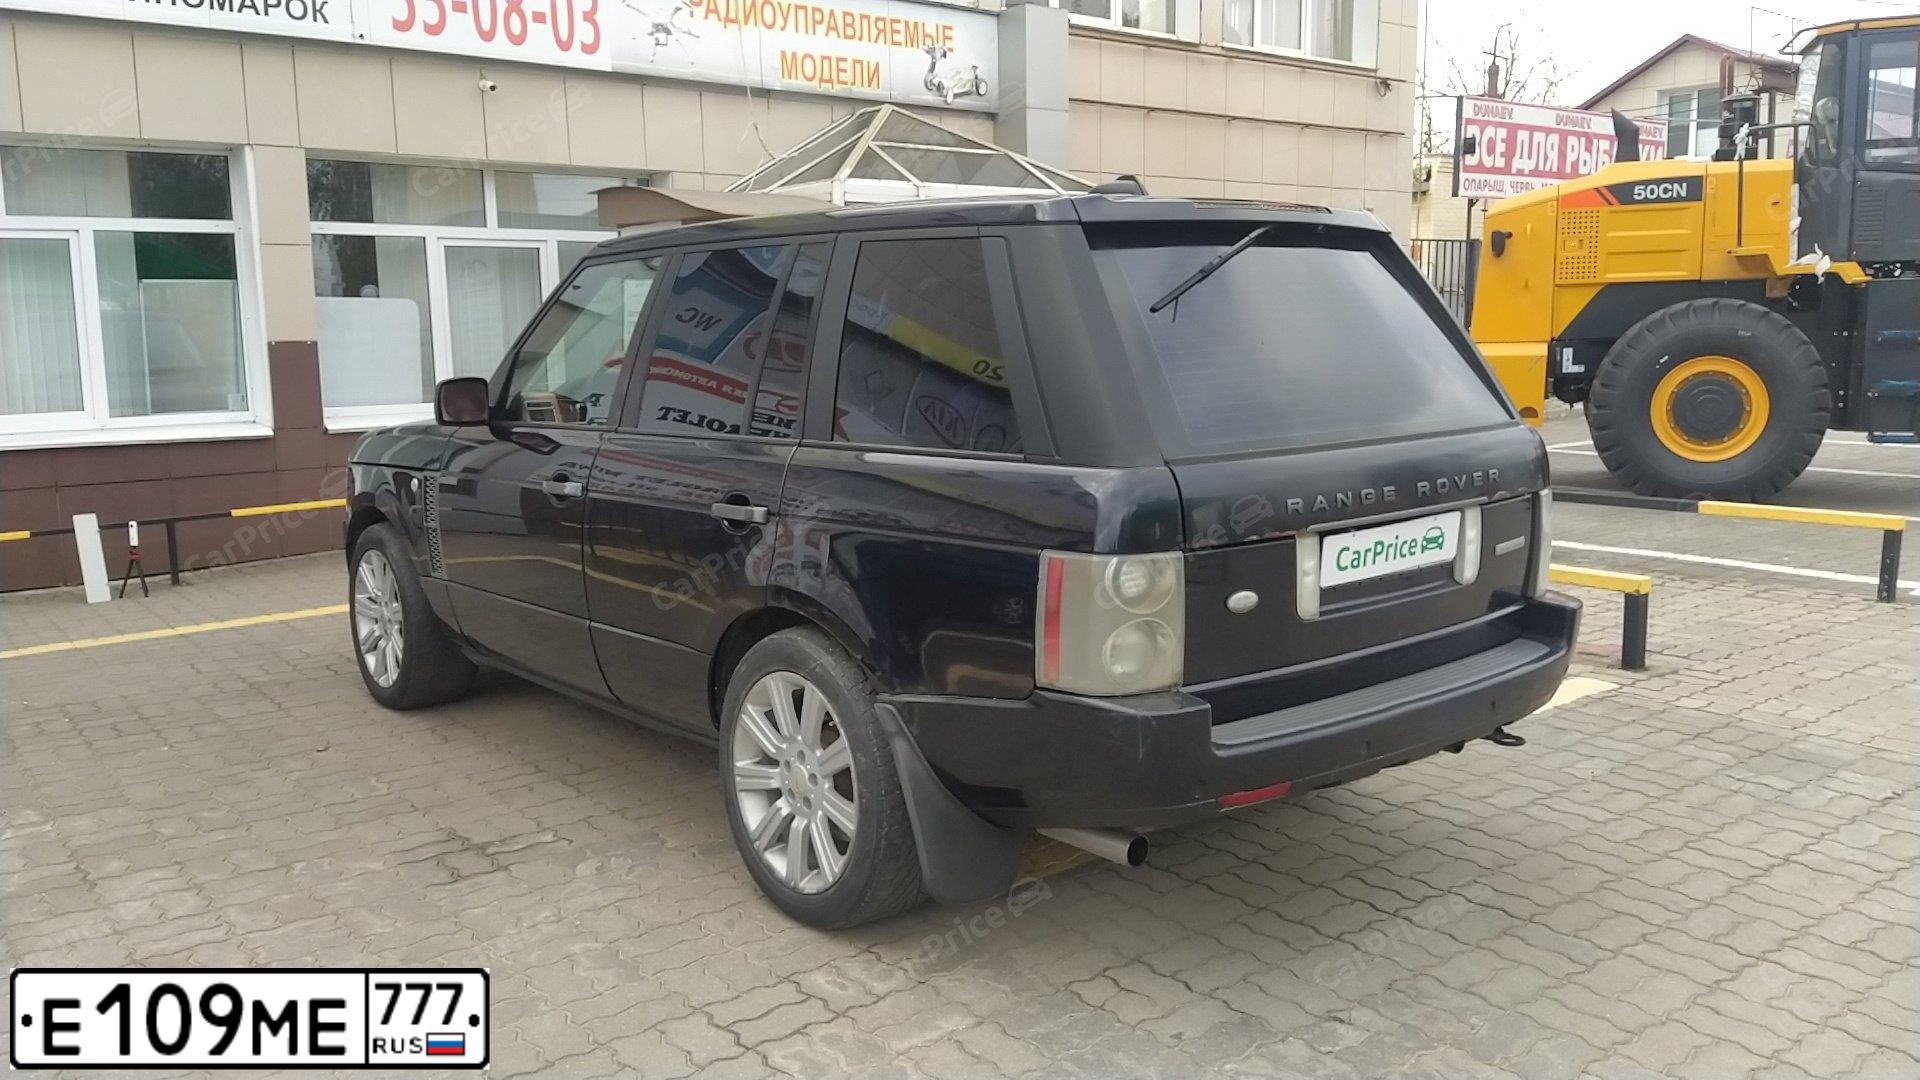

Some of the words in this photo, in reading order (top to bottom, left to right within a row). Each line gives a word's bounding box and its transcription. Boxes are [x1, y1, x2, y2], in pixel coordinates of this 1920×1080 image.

[129, 0, 329, 24] МАРОК
[780, 50, 881, 89] МОДЕЛИ
[1511, 129, 1560, 174] ДЛЯ
[1632, 183, 1687, 200] 50CN
[1286, 485, 1396, 515] RANGE
[1417, 468, 1501, 498] ROVER
[1336, 534, 1417, 572] CarPrice
